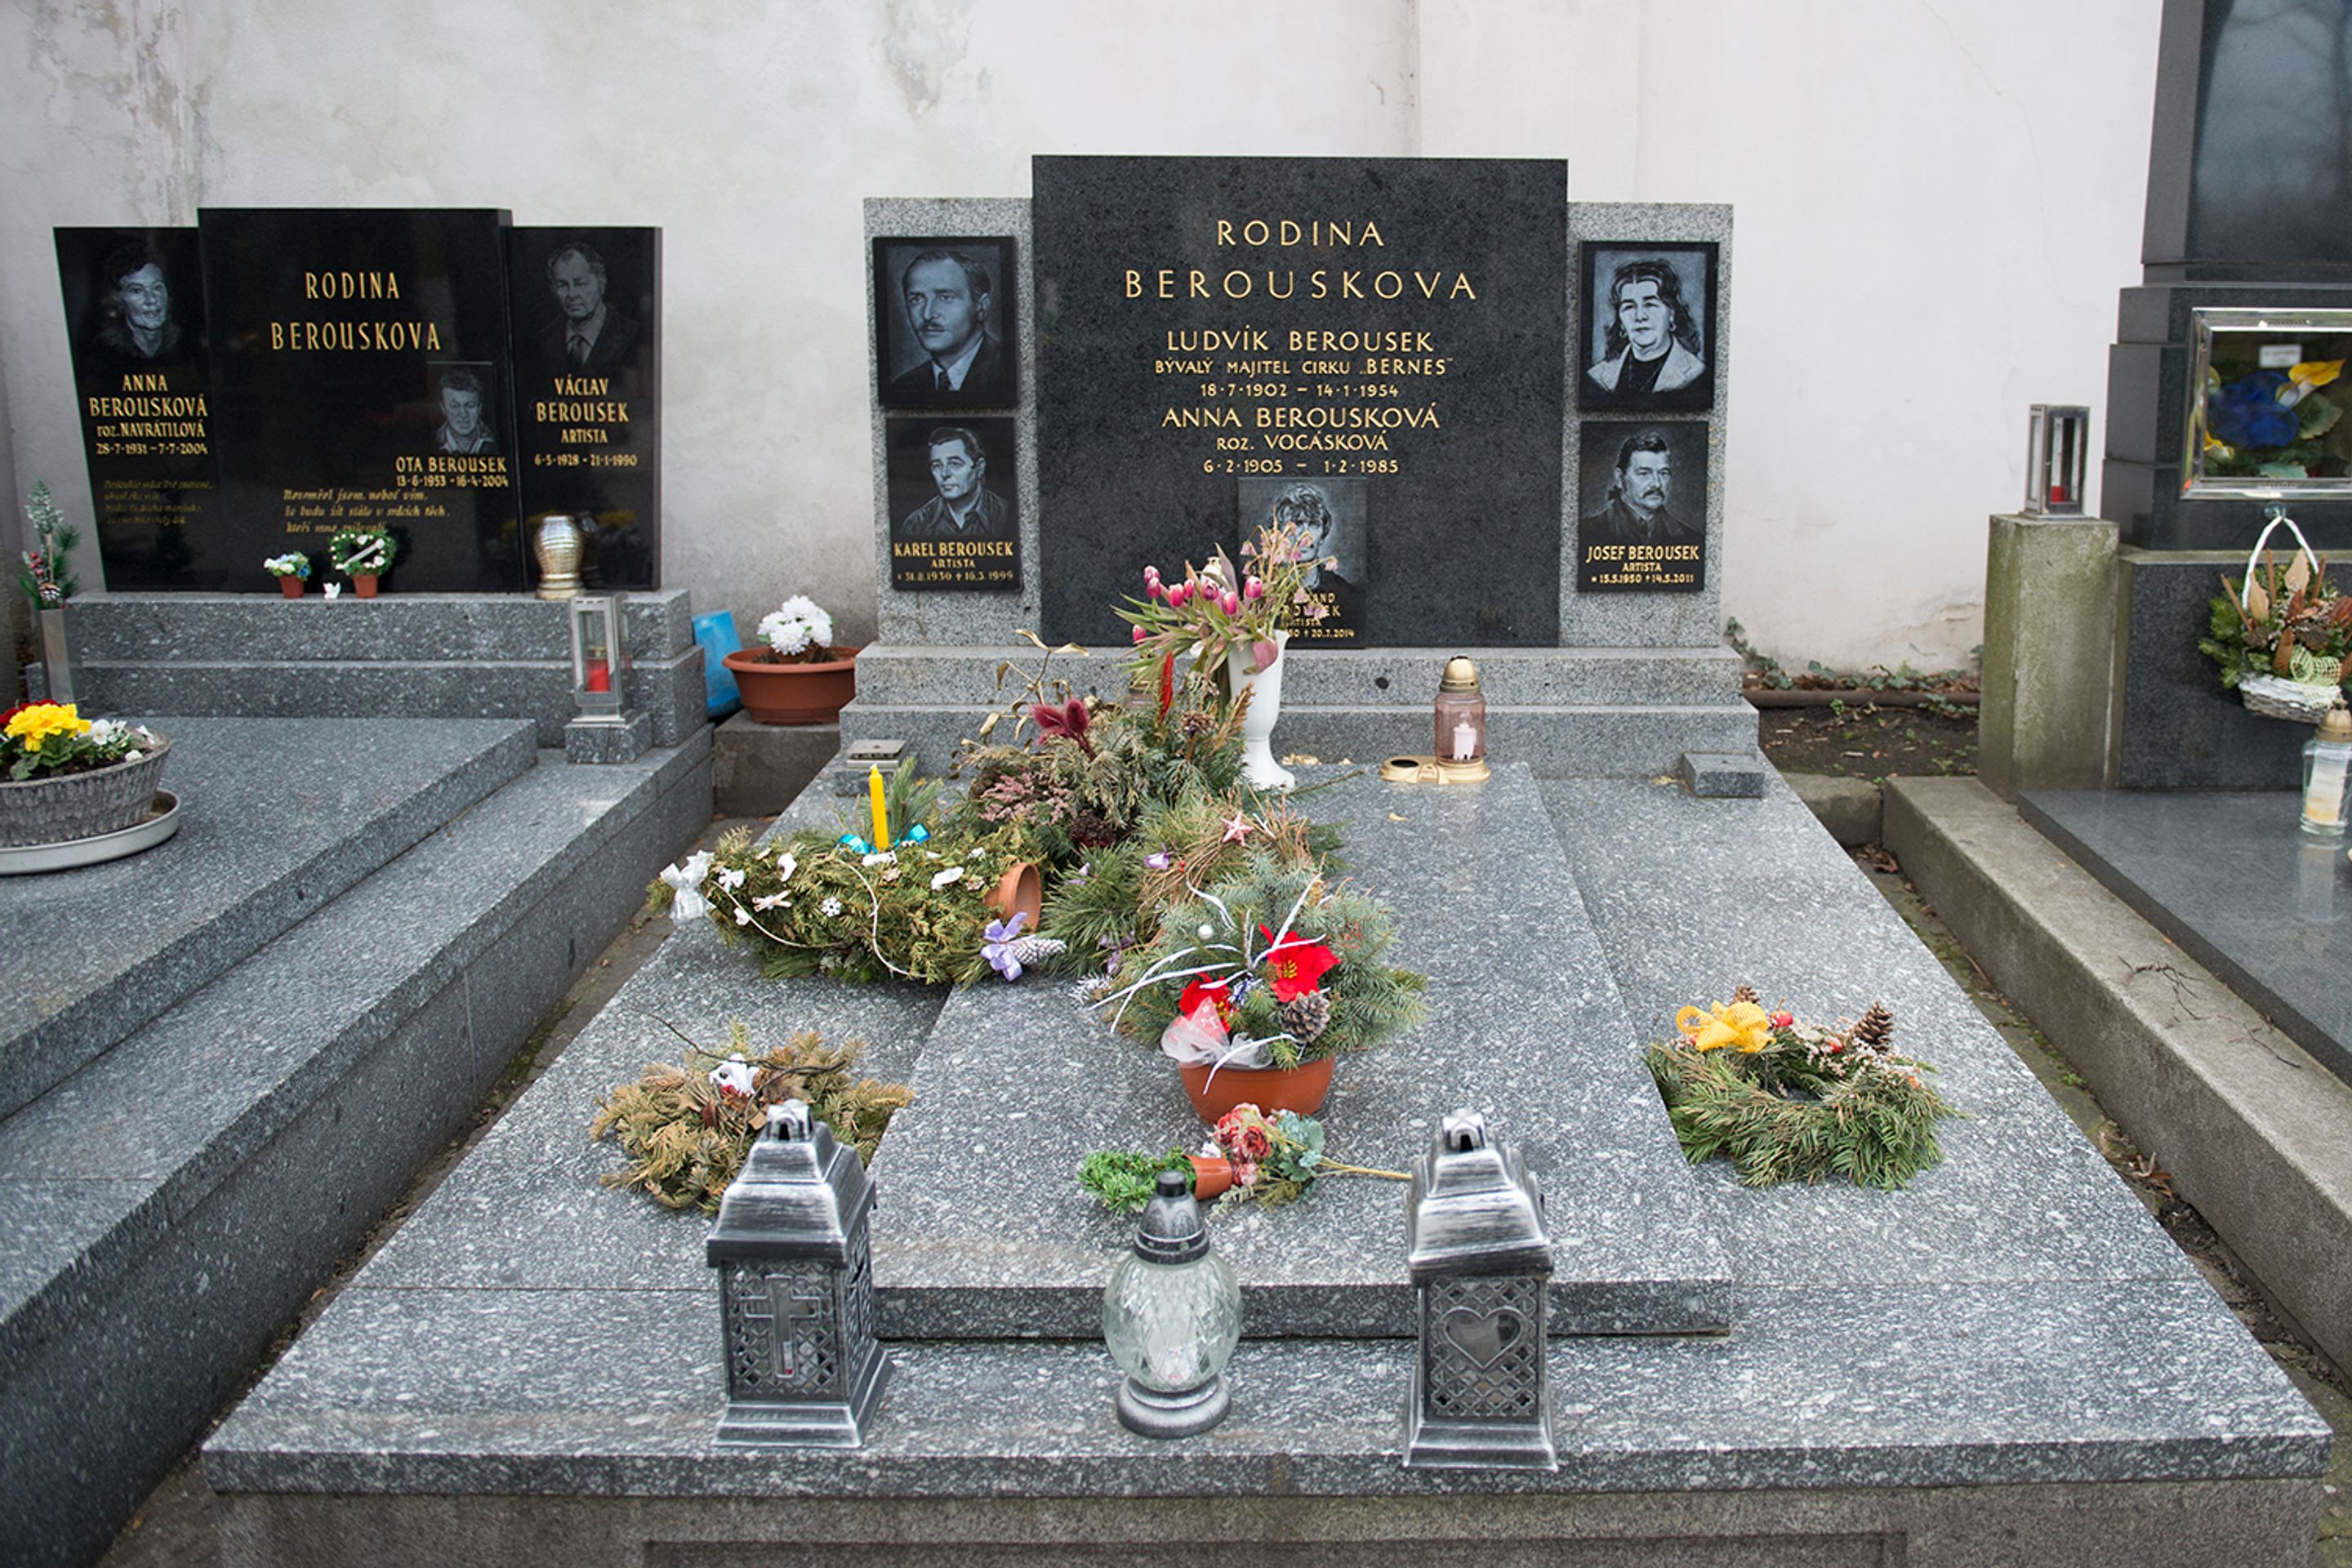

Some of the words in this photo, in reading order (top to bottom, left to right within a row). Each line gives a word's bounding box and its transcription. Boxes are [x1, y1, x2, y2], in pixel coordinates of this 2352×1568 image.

[1216, 220, 1385, 247] RODINA
[305, 271, 401, 300] RODINA
[1125, 269, 1477, 301] BEROUSKOVA
[270, 322, 442, 351] BEROUSKOVA
[1166, 324, 1269, 352] LUDVÍK
[1288, 330, 1434, 353] BEROUSEK
[1154, 356, 1214, 375] BÝVALÝ
[1226, 360, 1290, 378] MAJITEL
[1301, 360, 1351, 375] CIRKU
[122, 374, 168, 392] ANNA
[554, 373, 609, 396] VÁCLAV
[88, 394, 209, 417] BEROUSKOVÁ
[536, 401, 629, 422] BEROUSEK
[1161, 408, 1243, 429] ANNA
[1255, 402, 1441, 430] BEROUSKOVÁ
[561, 429, 608, 443] ARTISTA
[1215, 436, 1255, 451] ROZ.
[1263, 429, 1389, 451] VOCÁSKOVÁ
[395, 457, 423, 473] OTA
[428, 457, 508, 473] BEROUSEK
[893, 542, 937, 557] KAREL
[939, 541, 1014, 557] BEROUSEK
[1585, 546, 1626, 564] JOSEF
[1628, 546, 1700, 561] BEROUSEK
[930, 559, 976, 569] ARTISTA
[1622, 563, 1663, 572] ARTISTA
